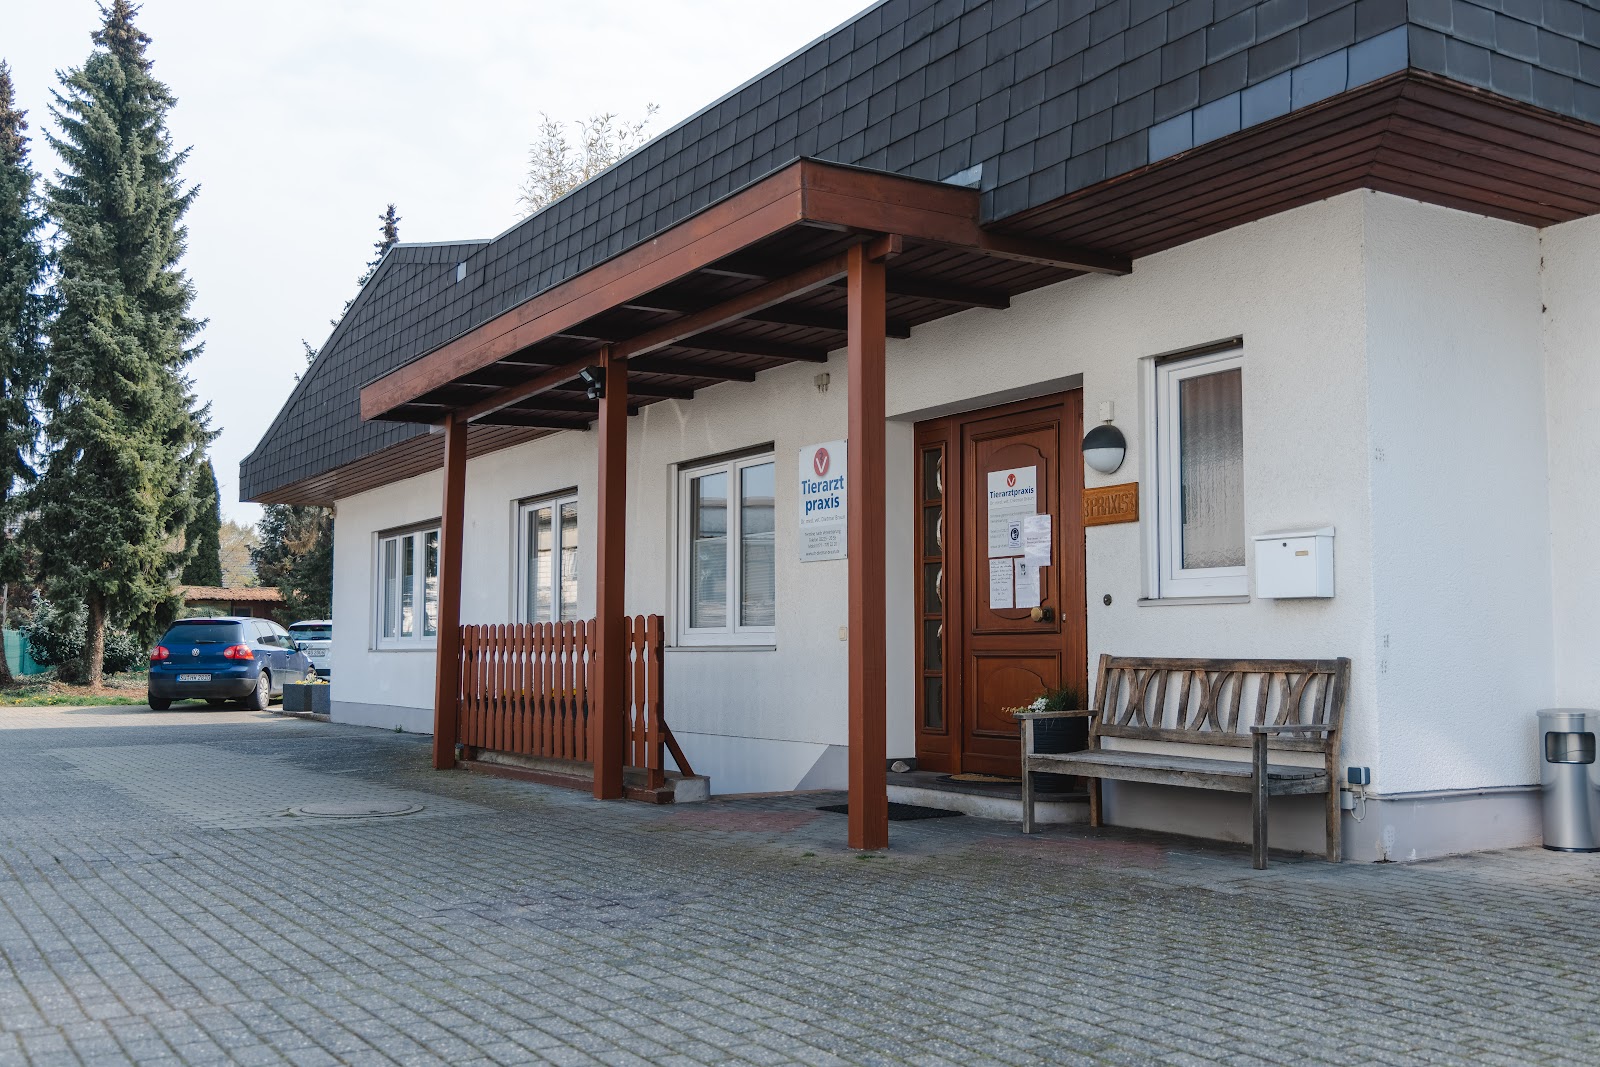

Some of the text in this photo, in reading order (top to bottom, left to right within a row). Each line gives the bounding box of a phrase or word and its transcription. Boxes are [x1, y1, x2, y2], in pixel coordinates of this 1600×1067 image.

[801, 475, 844, 495] Tierarzt
[989, 485, 1034, 499] Tierarztpraxis
[805, 493, 840, 516] praxis
[1088, 492, 1129, 517] PRAXIS
